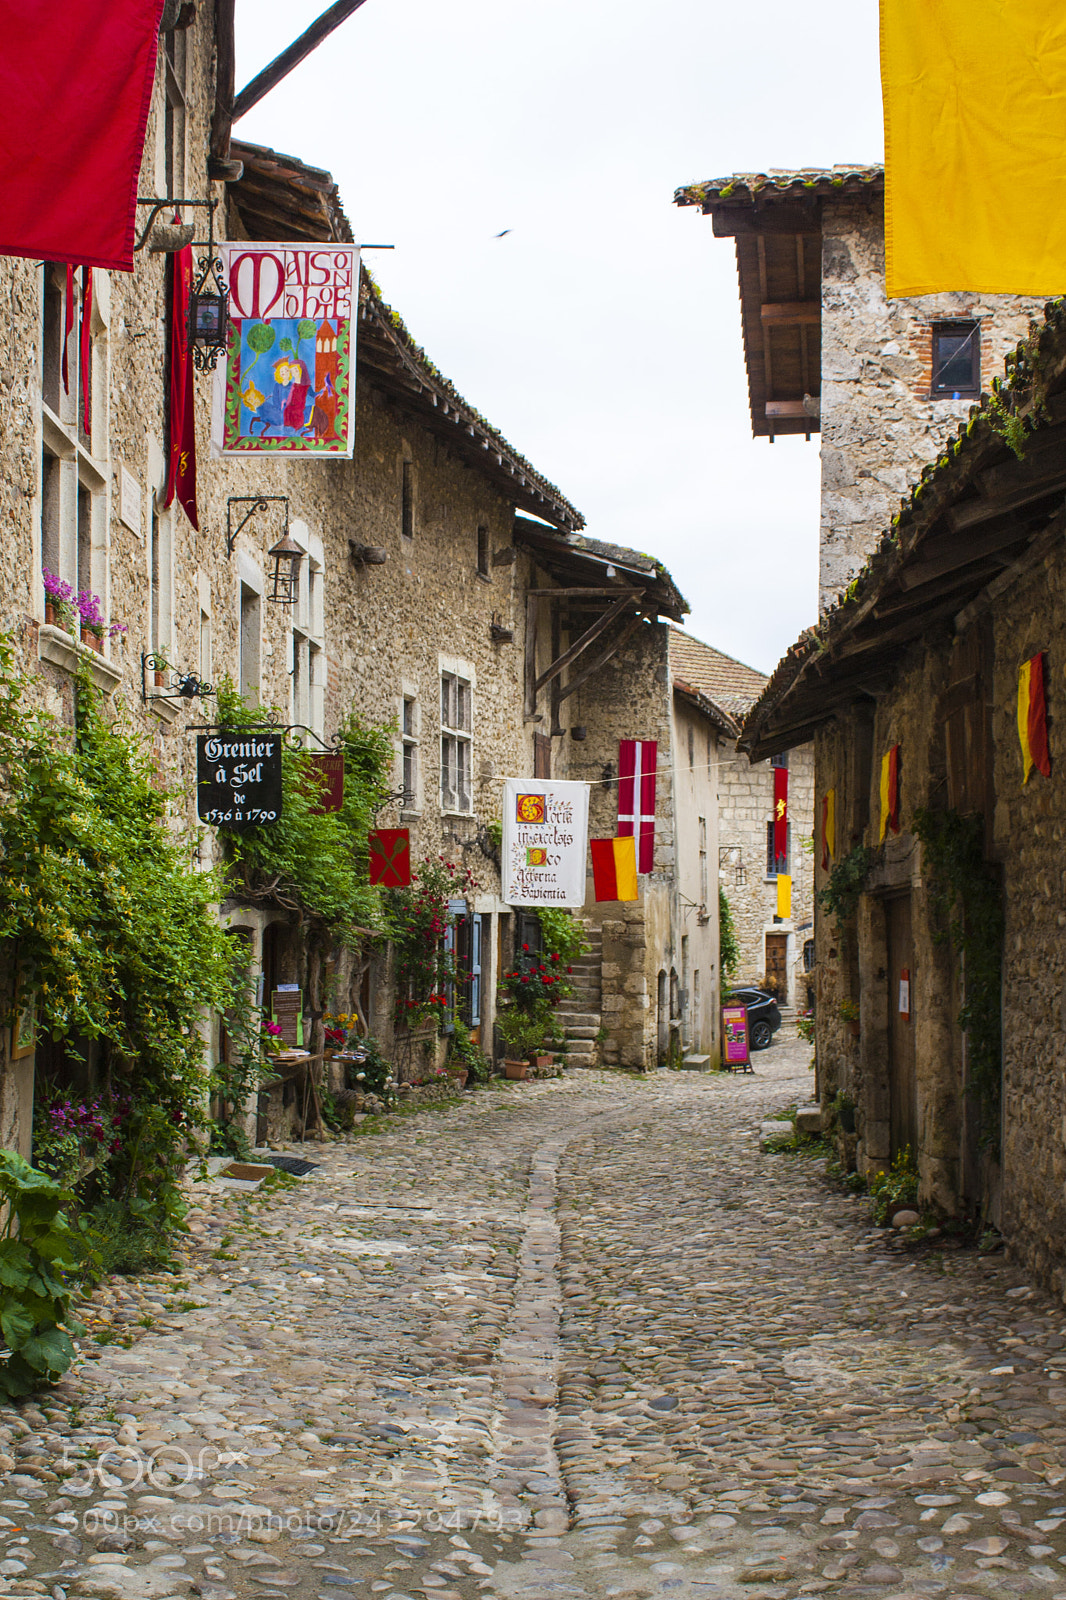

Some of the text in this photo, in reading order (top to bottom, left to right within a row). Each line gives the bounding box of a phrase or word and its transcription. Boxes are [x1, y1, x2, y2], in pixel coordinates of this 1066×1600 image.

[204, 738, 275, 763] Grenier
[215, 762, 264, 788] à Sel
[233, 791, 246, 805] de
[204, 808, 277, 824] 1536 à 1790
[516, 793, 574, 825] Gloria
[517, 831, 529, 845] in
[527, 848, 561, 867] Deo
[521, 886, 567, 900] Sapientia
